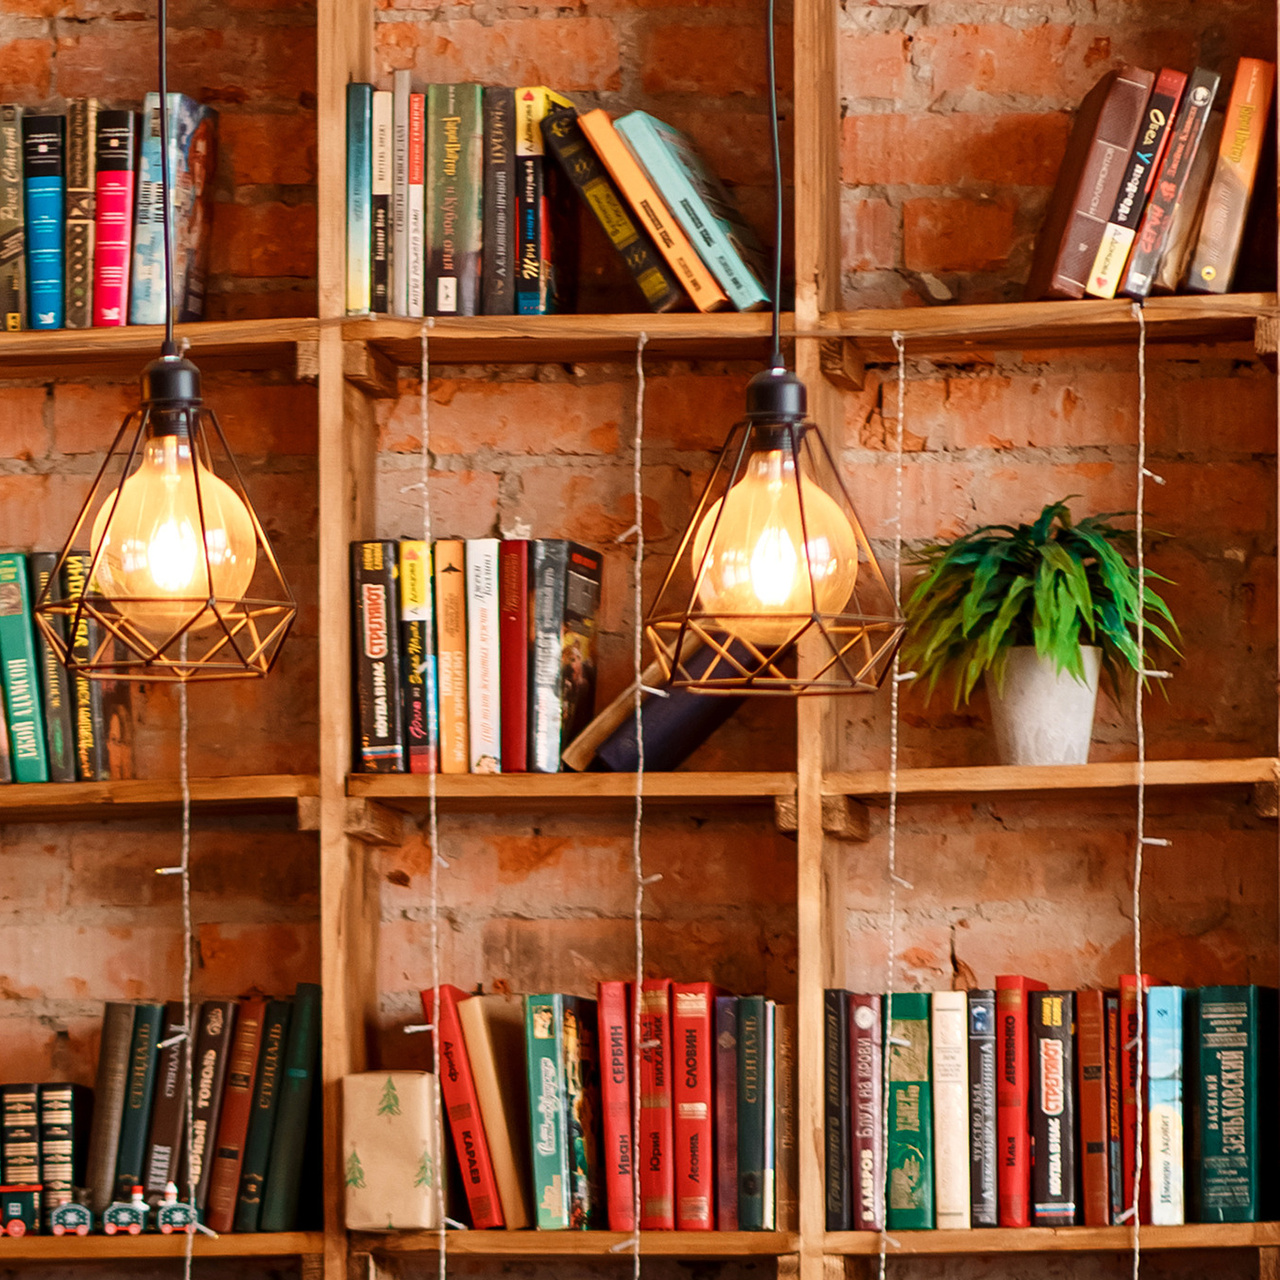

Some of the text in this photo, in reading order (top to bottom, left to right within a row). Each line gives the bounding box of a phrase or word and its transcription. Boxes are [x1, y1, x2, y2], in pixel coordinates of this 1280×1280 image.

[1143, 108, 1166, 146] Обед
[440, 196, 458, 236] Кубок
[1117, 163, 1145, 223] людоеда
[442, 239, 455, 271] огня
[366, 584, 385, 656] СТРЕЛЯЮТ
[375, 695, 388, 738] КОГДА
[130, 1022, 150, 1109] СТЕНДАЛЬ
[197, 1048, 216, 1108] ТОПОЛЬ
[258, 1022, 282, 1109] СТЕНДАЛЬ
[744, 1016, 758, 1104] СТЕНДАЛЬ
[856, 1037, 875, 1138] Блуд на крови
[1005, 1015, 1017, 1167] Илья ДЕРЕВЯНКО
[1042, 1039, 1062, 1113] СТРЕЛЯЮТ
[440, 1039, 481, 1184] Ариф КАРАЕВ
[610, 1025, 631, 1175] Иван СЕРБИН
[685, 1028, 700, 1183] Леонид СЛОВИН
[1205, 1074, 1218, 1130] ВАСИЛИЙ
[1216, 1050, 1246, 1154] ЗЕНЬКОВСКИЙ
[649, 1131, 663, 1172] Юрий
[973, 1112, 984, 1162] ЧУВСТВО
